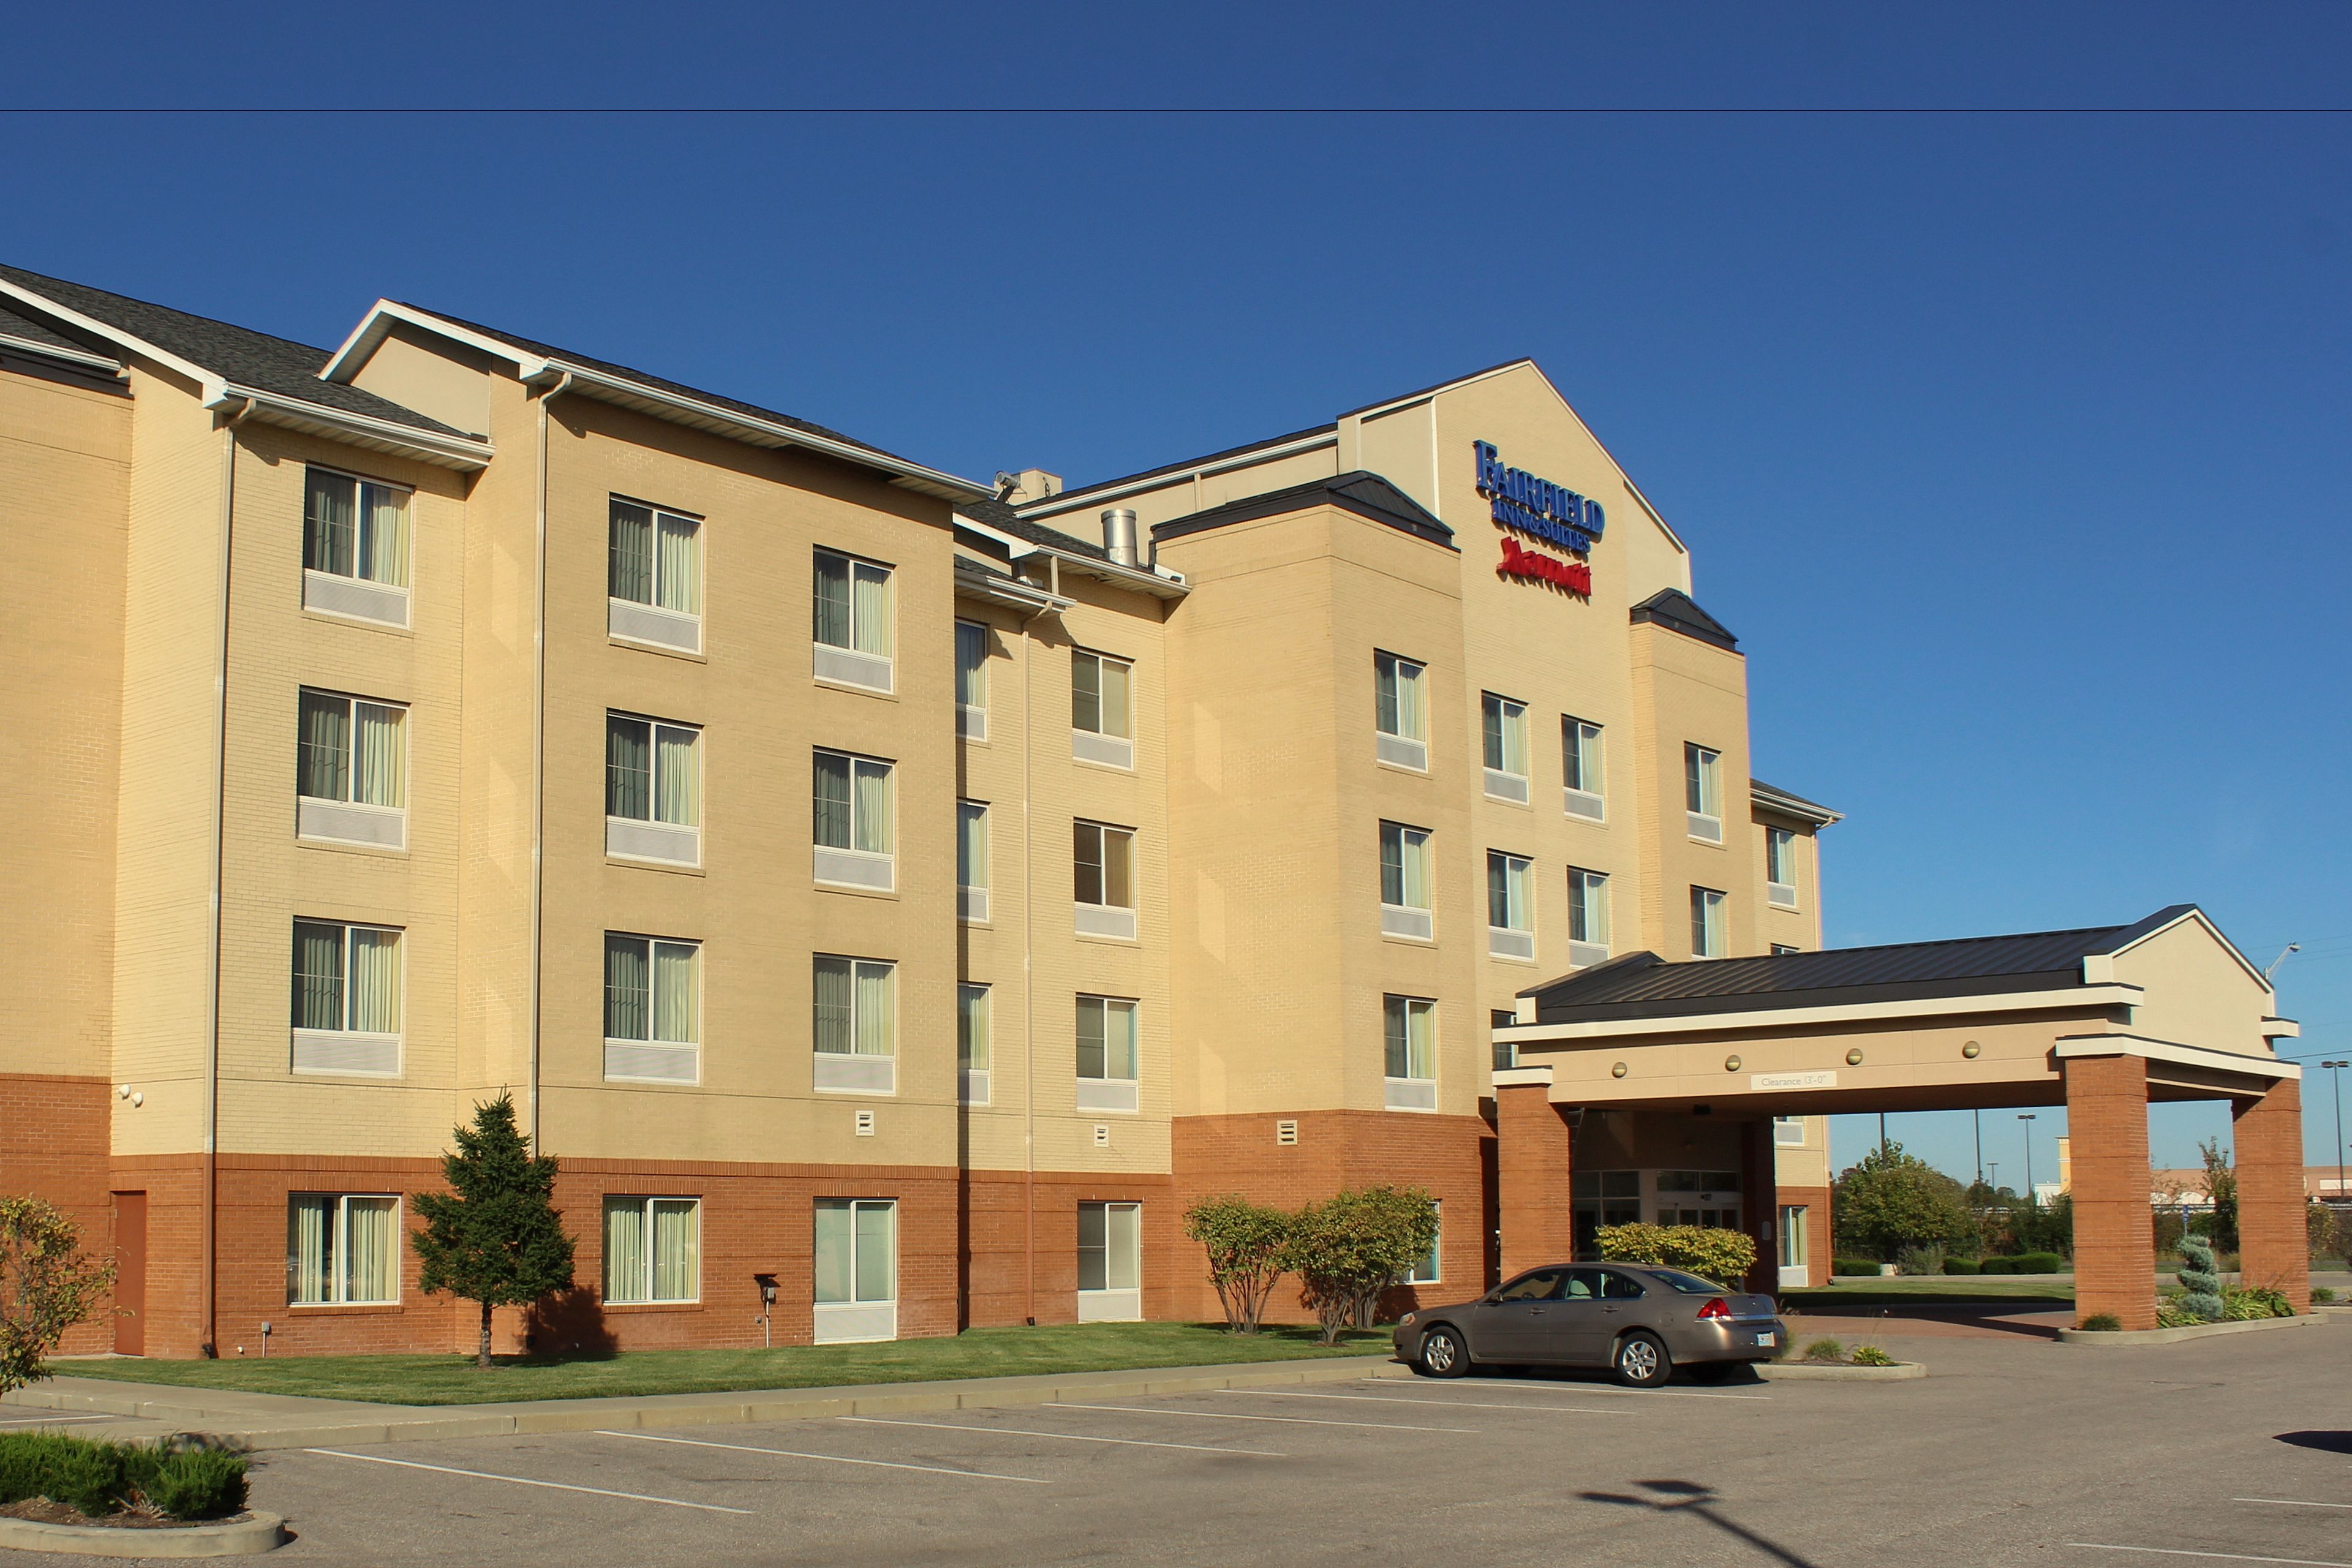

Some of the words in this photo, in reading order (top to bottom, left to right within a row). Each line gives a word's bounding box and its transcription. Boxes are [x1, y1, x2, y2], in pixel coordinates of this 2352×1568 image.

[1473, 440, 1605, 533] FAIRFIELD
[1491, 499, 1529, 530] INN
[1540, 519, 1590, 552] SUITES
[1761, 1078, 1801, 1087] Clearance
